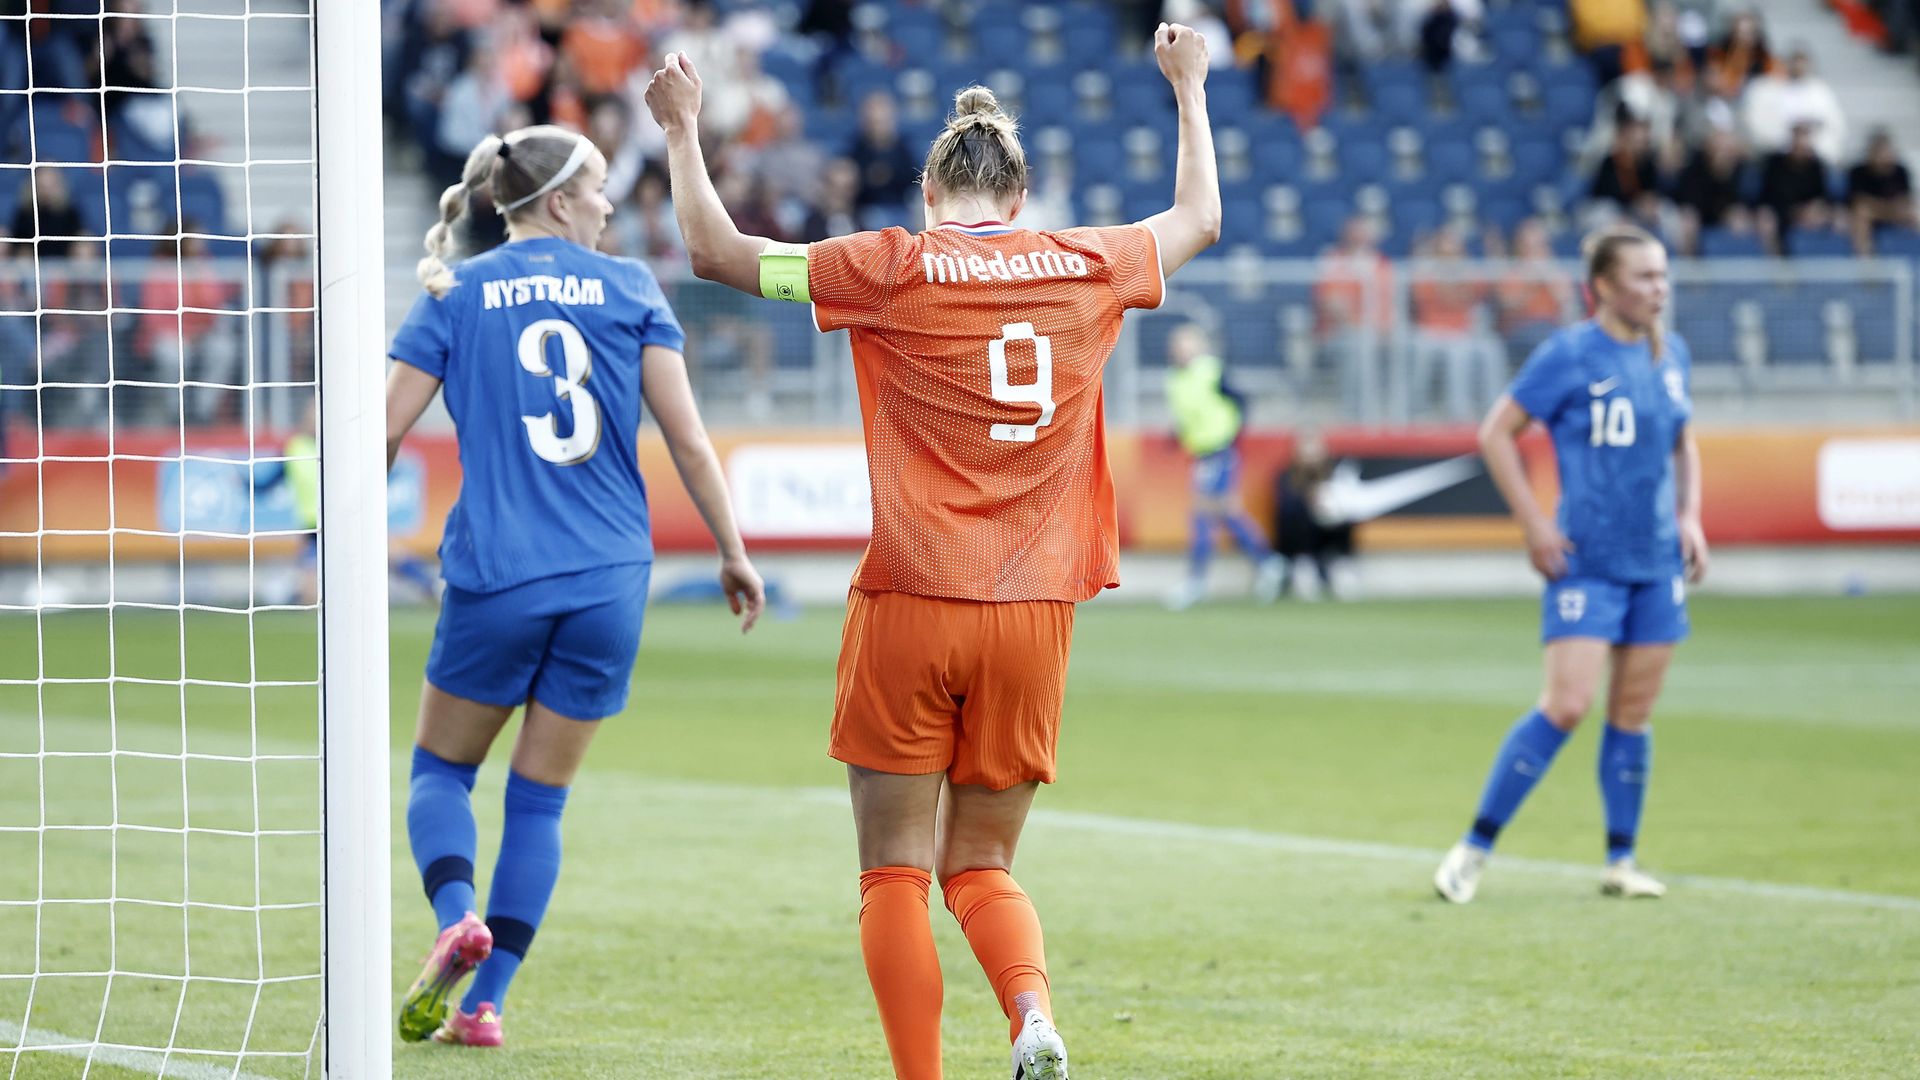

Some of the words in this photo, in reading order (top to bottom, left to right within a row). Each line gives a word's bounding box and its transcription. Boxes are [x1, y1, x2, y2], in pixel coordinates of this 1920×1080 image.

[517, 318, 602, 466] 3
[988, 322, 1056, 442] 9
[1589, 397, 1637, 448] 10
